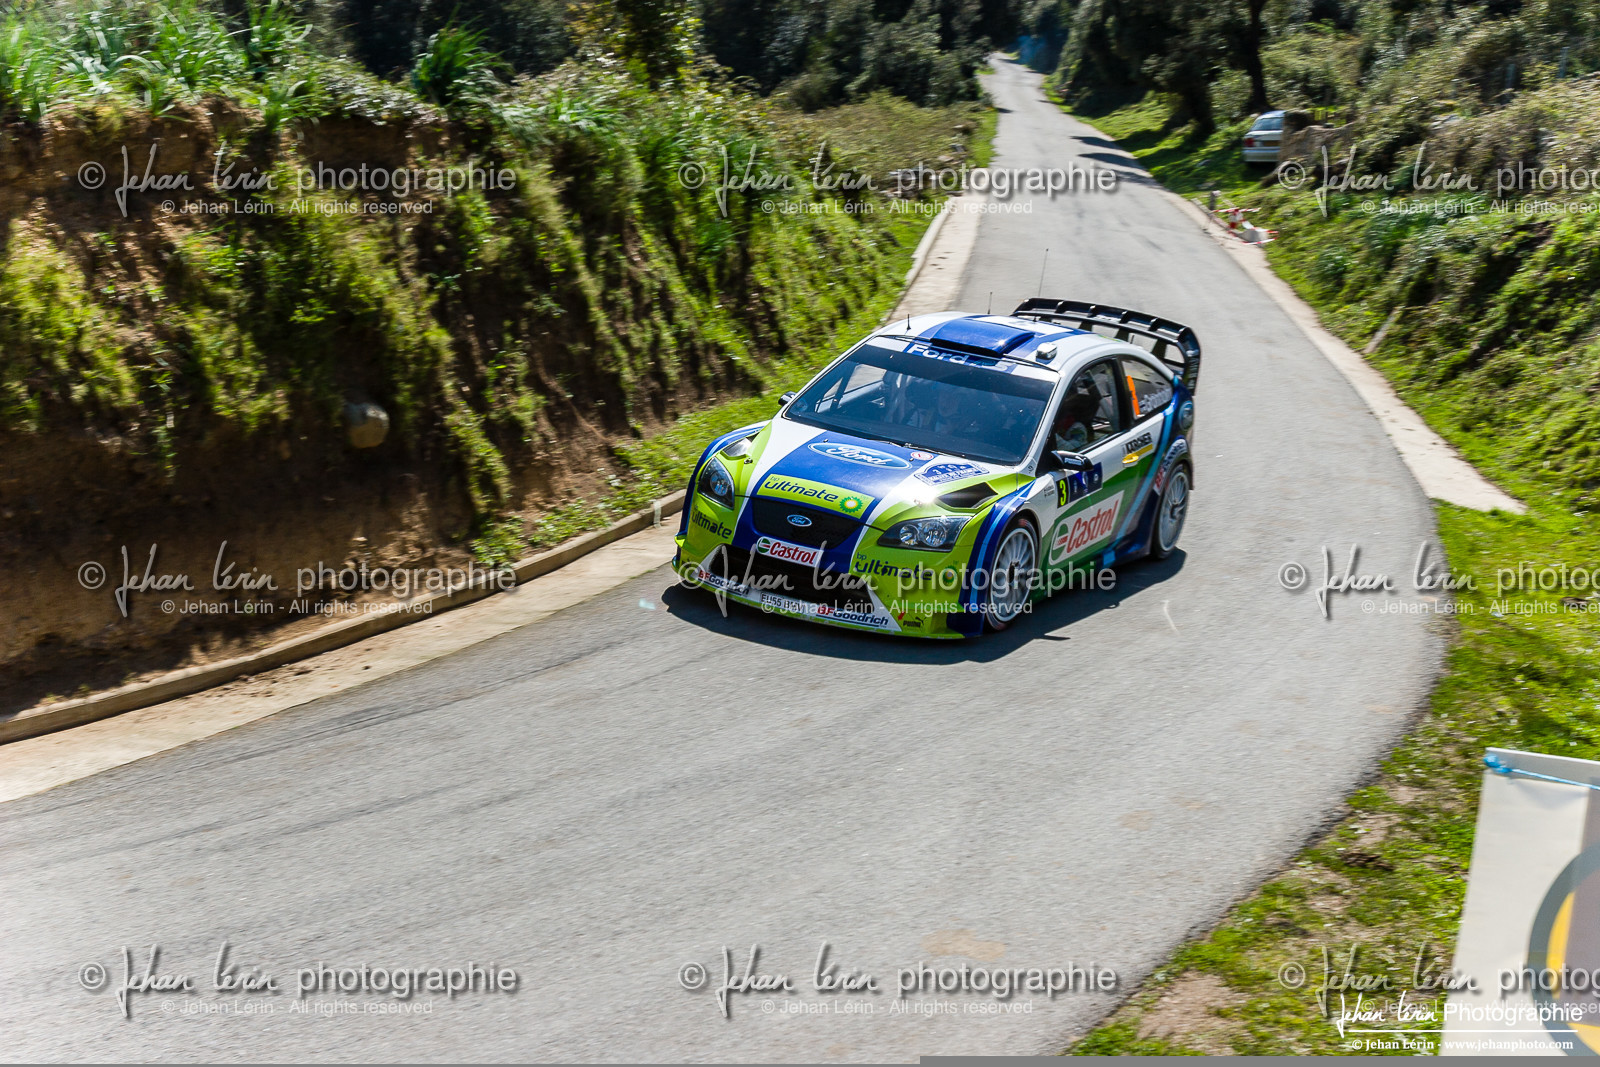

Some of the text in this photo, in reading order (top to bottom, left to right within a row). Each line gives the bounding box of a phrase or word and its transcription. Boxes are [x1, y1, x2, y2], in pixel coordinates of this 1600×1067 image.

[906, 344, 969, 365] Ford
[826, 446, 893, 465] Ford
[764, 480, 838, 502] ultimate
[1060, 480, 1067, 506] 3
[692, 510, 732, 539] ultimate
[1067, 500, 1119, 554] Castrol
[770, 542, 817, 565] Castrol
[856, 552, 867, 561] bp
[854, 559, 933, 580] ultimate
